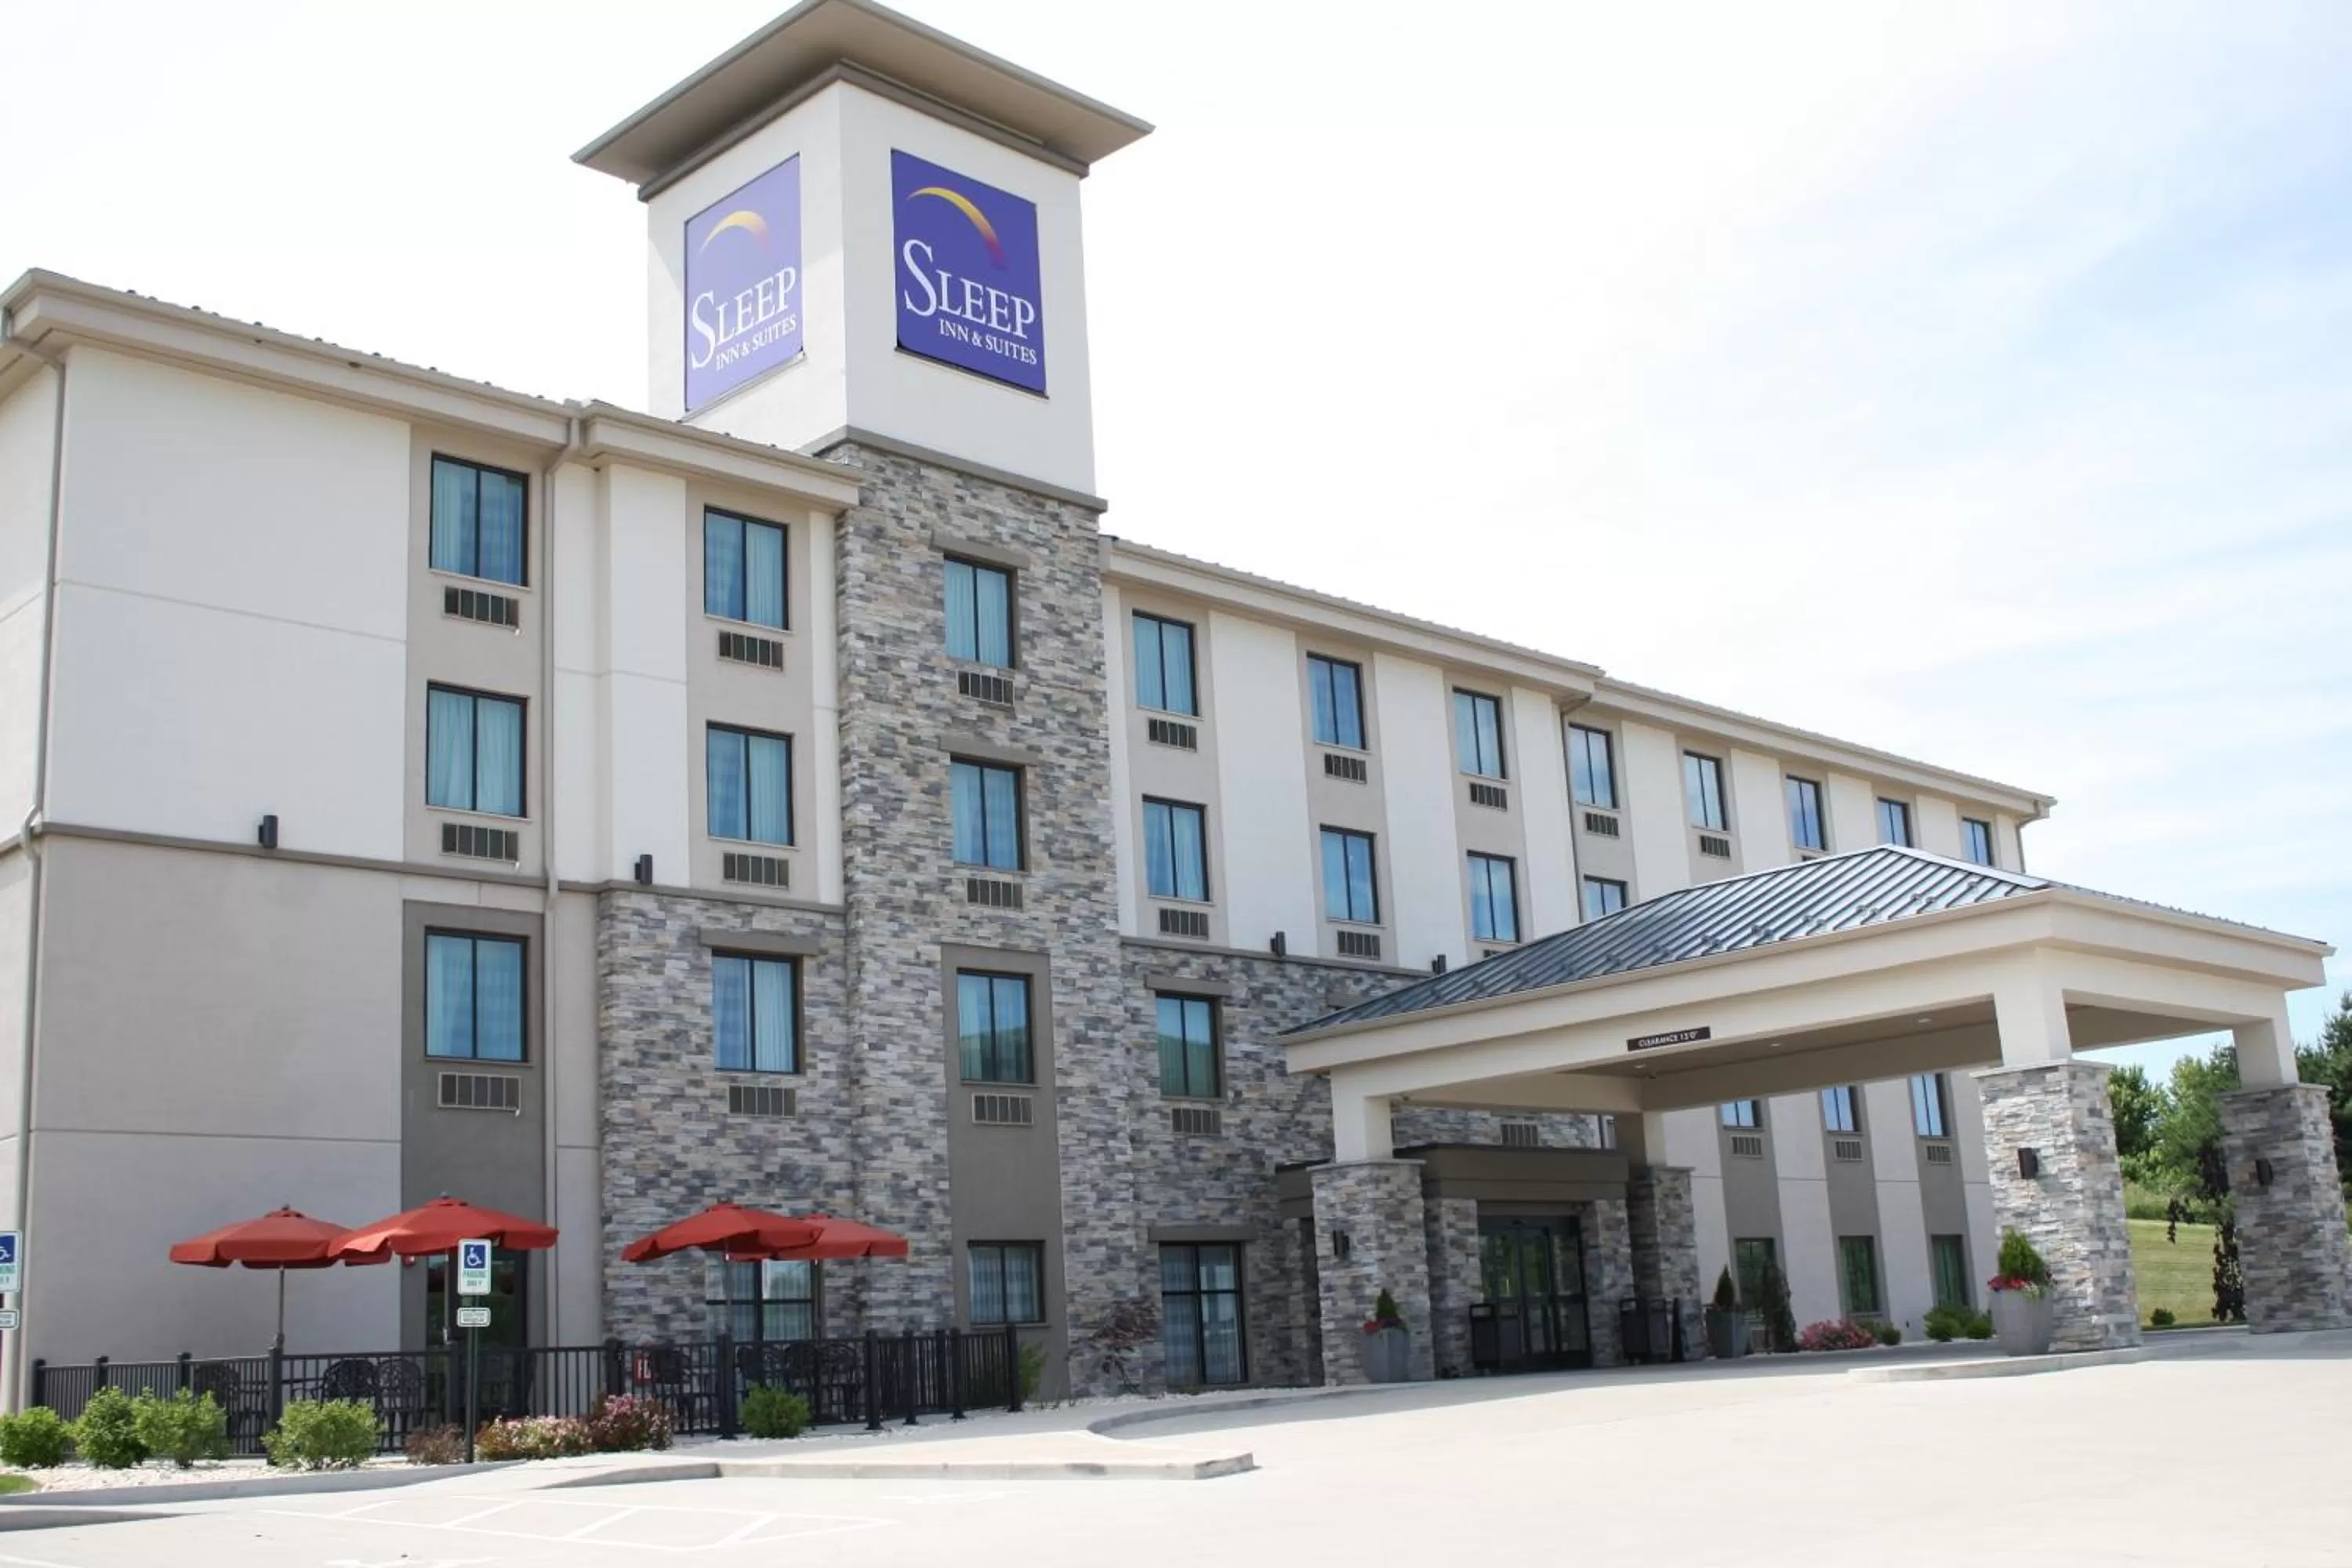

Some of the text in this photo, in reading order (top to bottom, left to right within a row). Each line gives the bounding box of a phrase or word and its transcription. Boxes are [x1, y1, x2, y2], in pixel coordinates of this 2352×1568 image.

[903, 239, 1035, 339] SLEEP
[691, 266, 797, 371] SLEEP
[717, 314, 797, 371] INN & SUITES
[939, 318, 1037, 365] INN & SUITES
[1638, 1034, 1678, 1047] CLEARANCE
